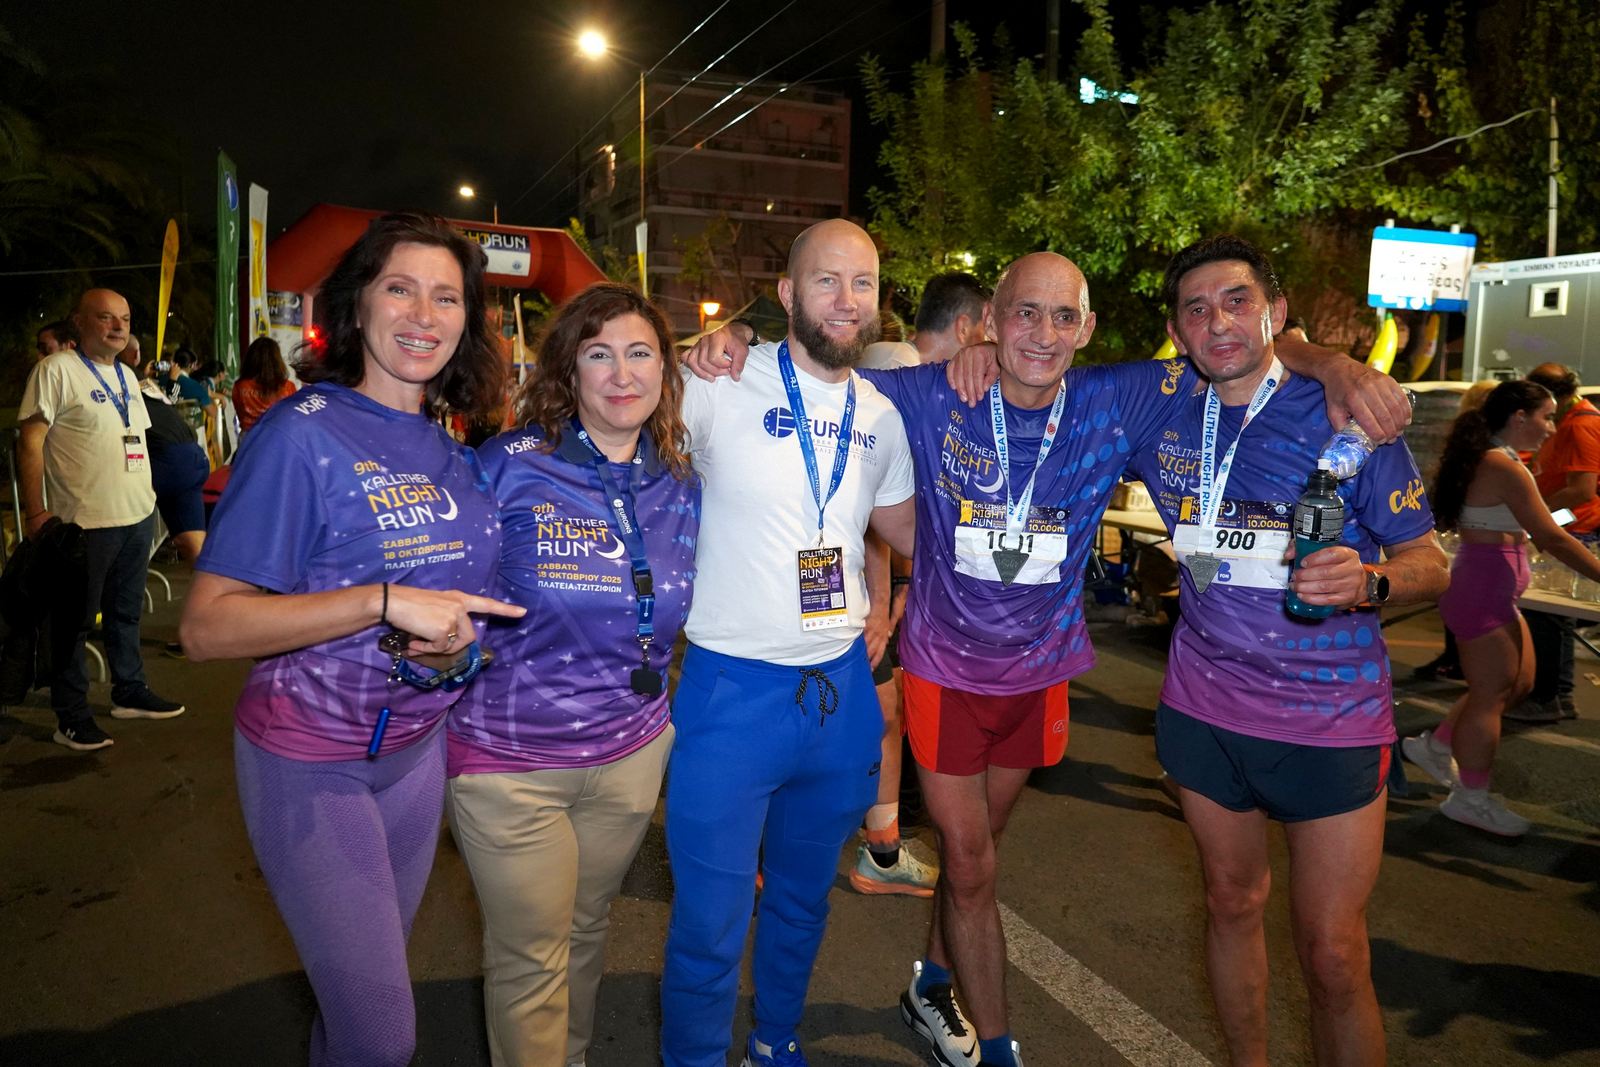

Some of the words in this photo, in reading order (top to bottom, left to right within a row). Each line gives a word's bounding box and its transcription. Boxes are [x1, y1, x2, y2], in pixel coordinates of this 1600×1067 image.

[491, 234, 526, 249] RUN
[1252, 386, 1274, 413] EUROINS
[992, 400, 1006, 434] NIGHT
[1204, 391, 1218, 449] KALLITHEA
[354, 460, 380, 475] 9th
[941, 450, 970, 485] RUN
[1202, 452, 1212, 488] NIGHT
[361, 474, 432, 492] KALLITHEA
[1160, 469, 1186, 492] RUN
[368, 485, 441, 513] NIGHT
[377, 504, 435, 531] RUN
[619, 508, 632, 533] EUROINS
[972, 509, 1006, 519] NIGHT
[971, 518, 993, 527] RUN
[1029, 524, 1066, 533] 10.000m
[1247, 519, 1289, 529] 10.000m
[537, 522, 608, 542] NIGHT
[1216, 529, 1256, 550] 900
[384, 535, 429, 549] ΣΑΒΒΑΤΟ
[398, 542, 447, 558] ΟΚΤΩΒΡΙΟΥ
[537, 541, 589, 557] RUN
[800, 549, 833, 558] KALLITHEA
[385, 558, 426, 571] ΠΛΑΤΕΙΑ
[800, 556, 833, 569] NIGHT
[548, 572, 599, 582] ΟΚΤΩΒΡΙΟΥ
[601, 576, 622, 584] 2025
[800, 568, 823, 580] RUN
[538, 580, 574, 590] ΠΛΑΤΕΙΑ
[577, 584, 622, 593] ΤΖΙΤΖΙΦΙΩΝ
